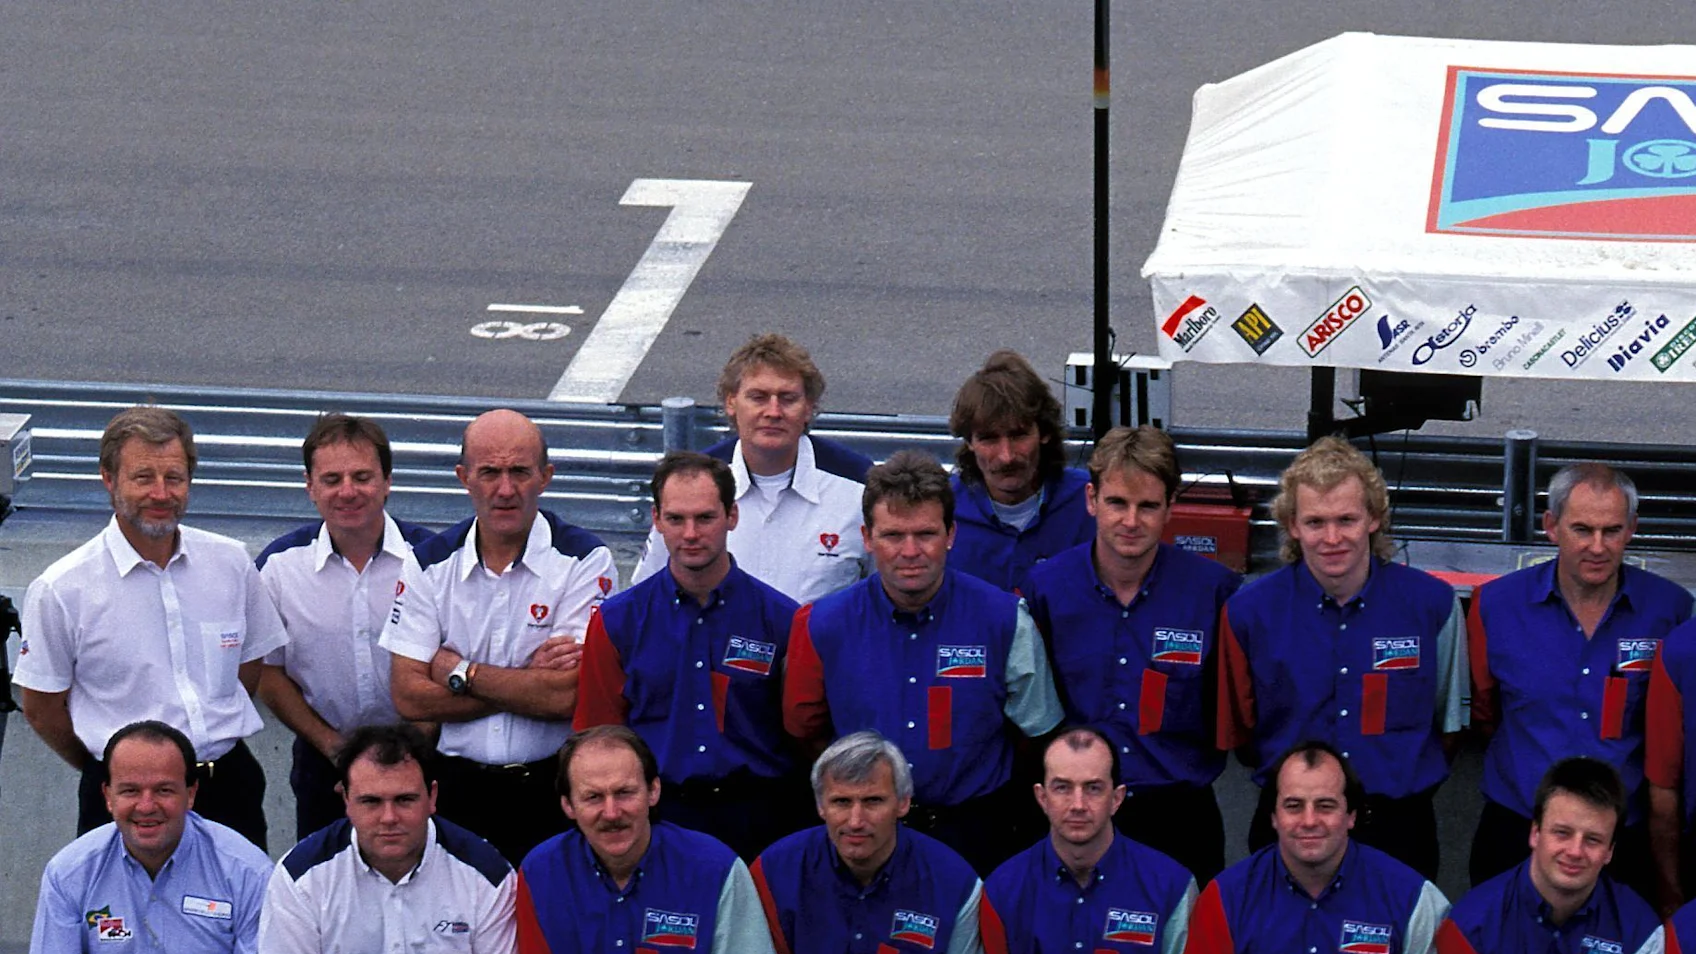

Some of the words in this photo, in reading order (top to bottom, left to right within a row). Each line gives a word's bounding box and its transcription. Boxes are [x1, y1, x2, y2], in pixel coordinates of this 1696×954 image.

[1174, 305, 1218, 346] Marlboro
[1242, 310, 1272, 343] API
[1307, 294, 1365, 352] ARISCO
[1478, 316, 1520, 354] brembo
[1561, 315, 1619, 368] Delicius
[1607, 314, 1671, 373] Diavia
